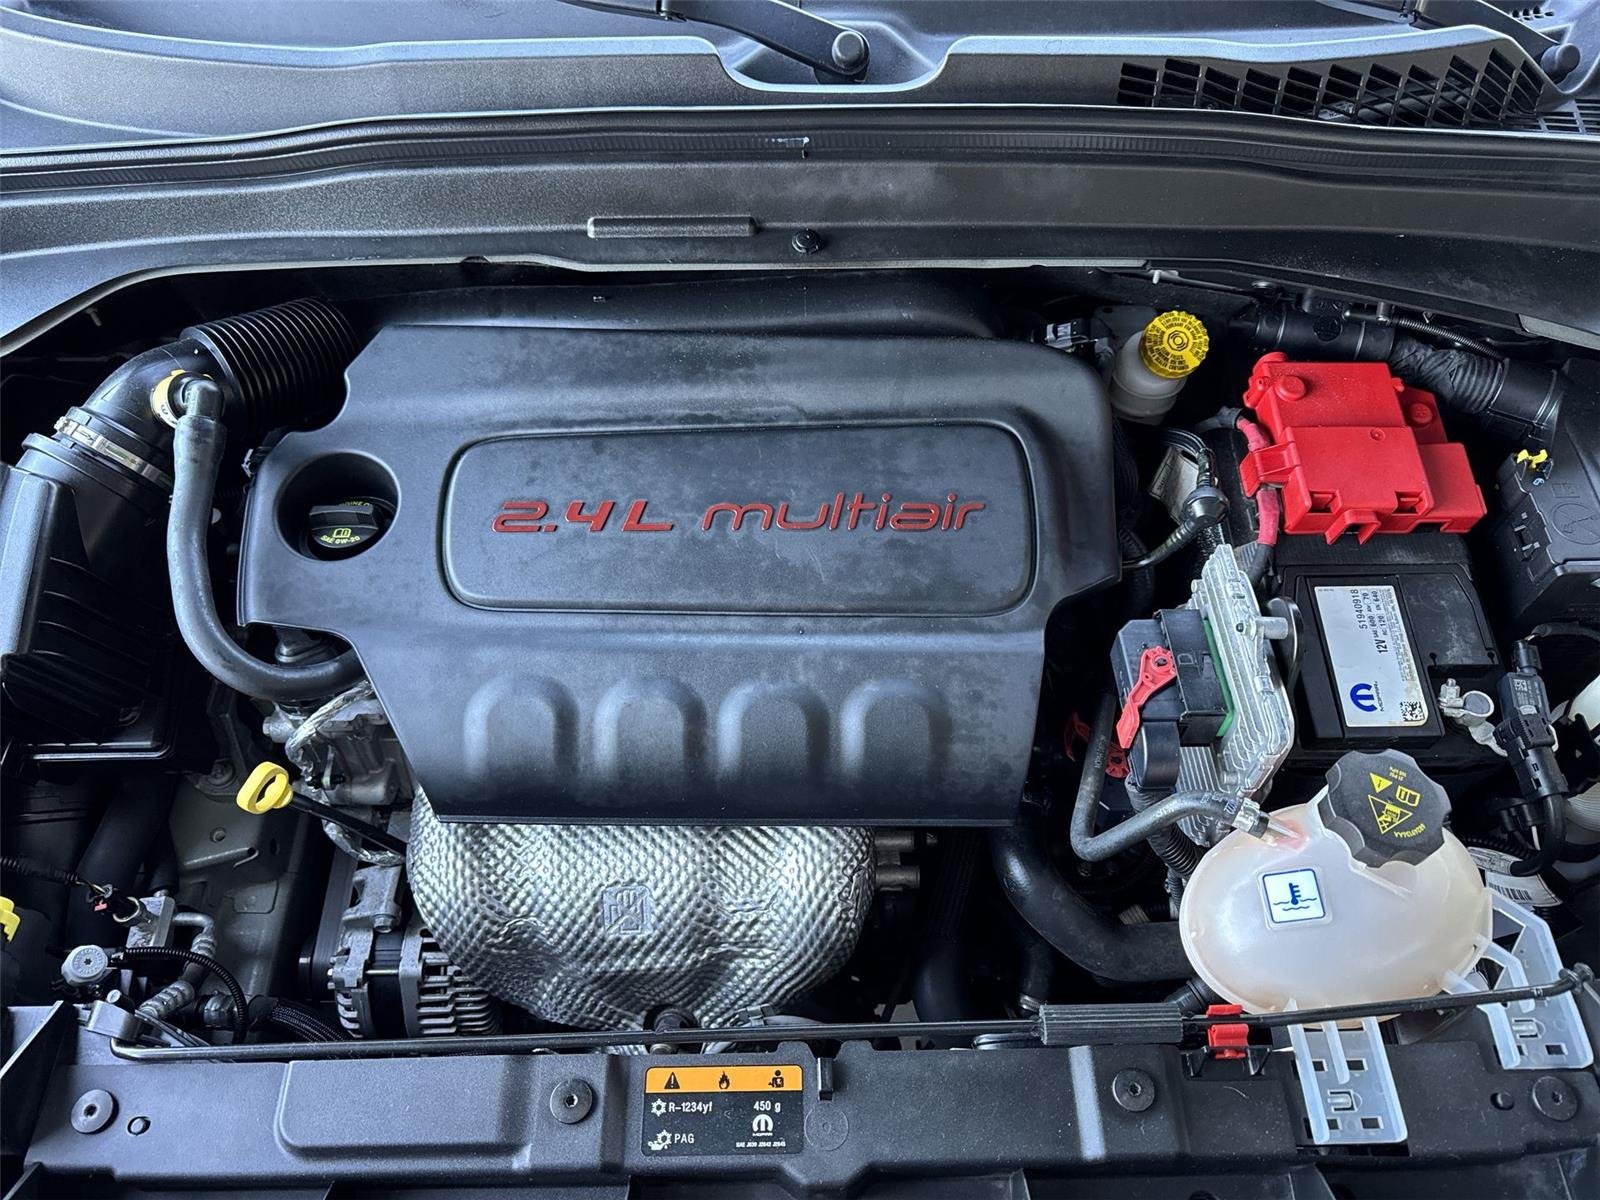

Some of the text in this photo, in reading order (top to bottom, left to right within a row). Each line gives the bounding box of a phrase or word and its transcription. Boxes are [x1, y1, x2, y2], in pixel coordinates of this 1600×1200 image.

[702, 491, 986, 533] multiair
[320, 535, 335, 544] SAE
[1350, 589, 1368, 630] 51940918
[1368, 616, 1376, 628] 600
[1378, 615, 1387, 628] 120
[1376, 640, 1388, 654] 12V
[668, 1101, 781, 1114] R-1234yf 450 g
[674, 1134, 694, 1144] PAG
